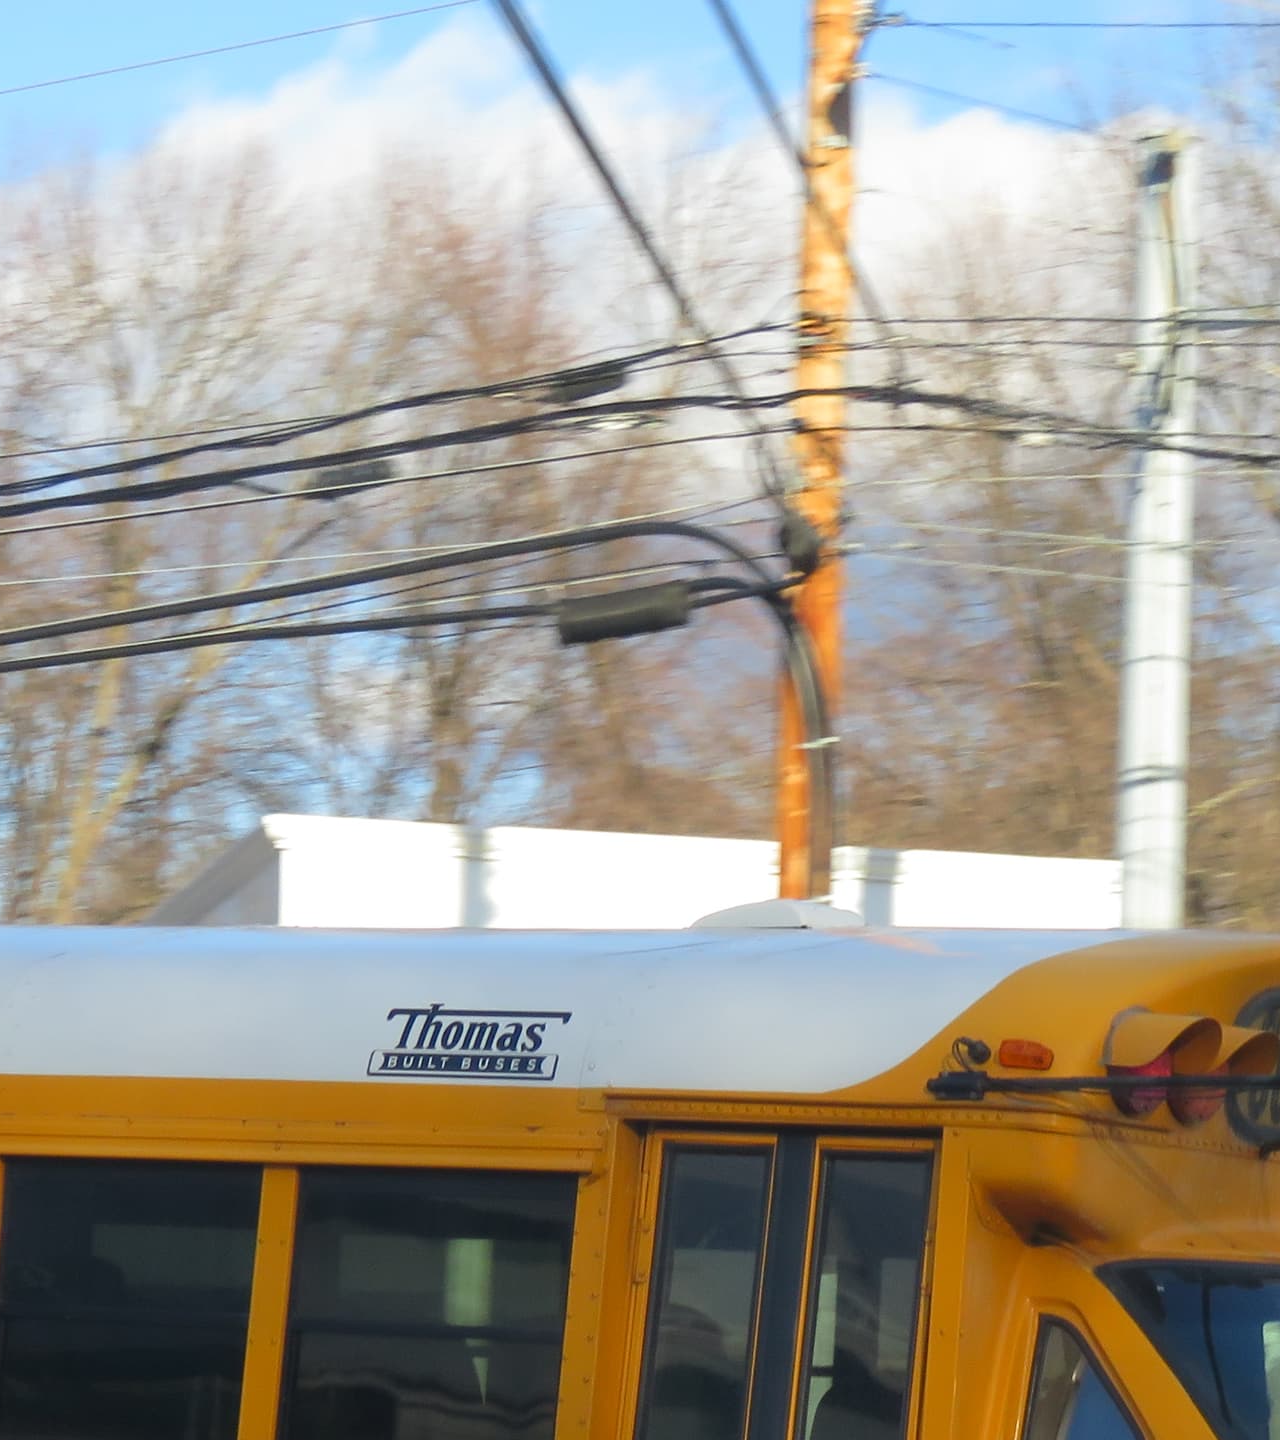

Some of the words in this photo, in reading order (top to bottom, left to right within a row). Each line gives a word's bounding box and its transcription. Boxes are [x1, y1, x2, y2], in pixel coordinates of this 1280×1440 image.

[387, 1003, 572, 1052] Thomas
[386, 1057, 449, 1070] BUILT
[461, 1058, 537, 1073] BUSES
